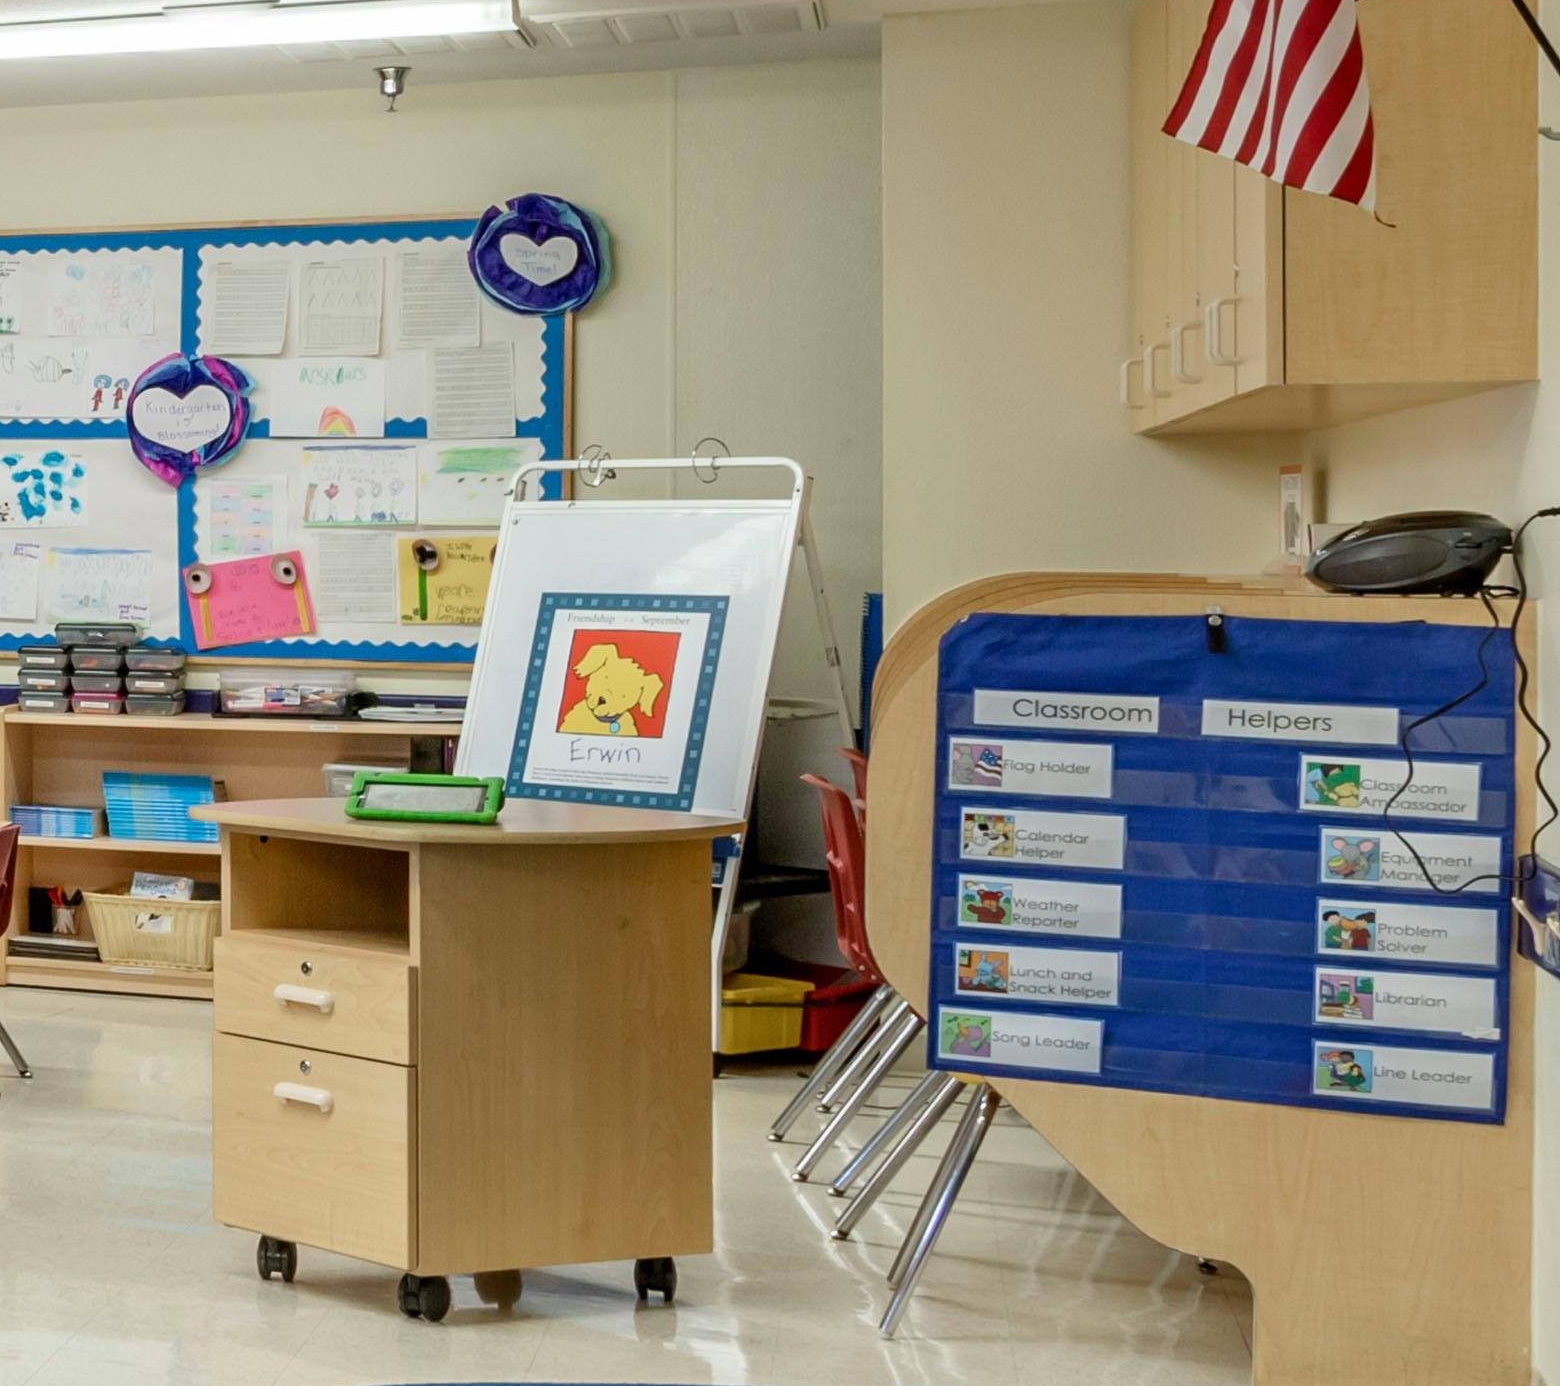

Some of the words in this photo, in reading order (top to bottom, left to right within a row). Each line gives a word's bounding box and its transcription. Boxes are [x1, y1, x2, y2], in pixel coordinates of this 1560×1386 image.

[146, 401, 226, 420] Kindergarten
[567, 613, 616, 625] Friendship
[641, 615, 691, 626] September
[1012, 698, 1153, 723] Classroom
[1228, 708, 1333, 733] Helpers
[570, 738, 641, 764] Erwin
[1003, 758, 1035, 774] Flag
[1039, 760, 1091, 775] Holder
[1015, 829, 1089, 845] Calendar
[1015, 846, 1065, 861] Helper
[1012, 897, 1080, 913] Weather
[1012, 913, 1080, 929] Reporter
[1377, 923, 1448, 939] Problem
[1377, 940, 1428, 954] Solver
[1010, 966, 1057, 980] Lunch
[1060, 968, 1093, 982] and
[1010, 982, 1056, 996] Snack
[1060, 985, 1113, 1001] Helper
[1375, 992, 1448, 1009] Librarian
[992, 1030, 1031, 1047] Song
[1035, 1034, 1090, 1051] Leader
[1373, 1066, 1407, 1080] Line
[1412, 1066, 1473, 1085] Leader
